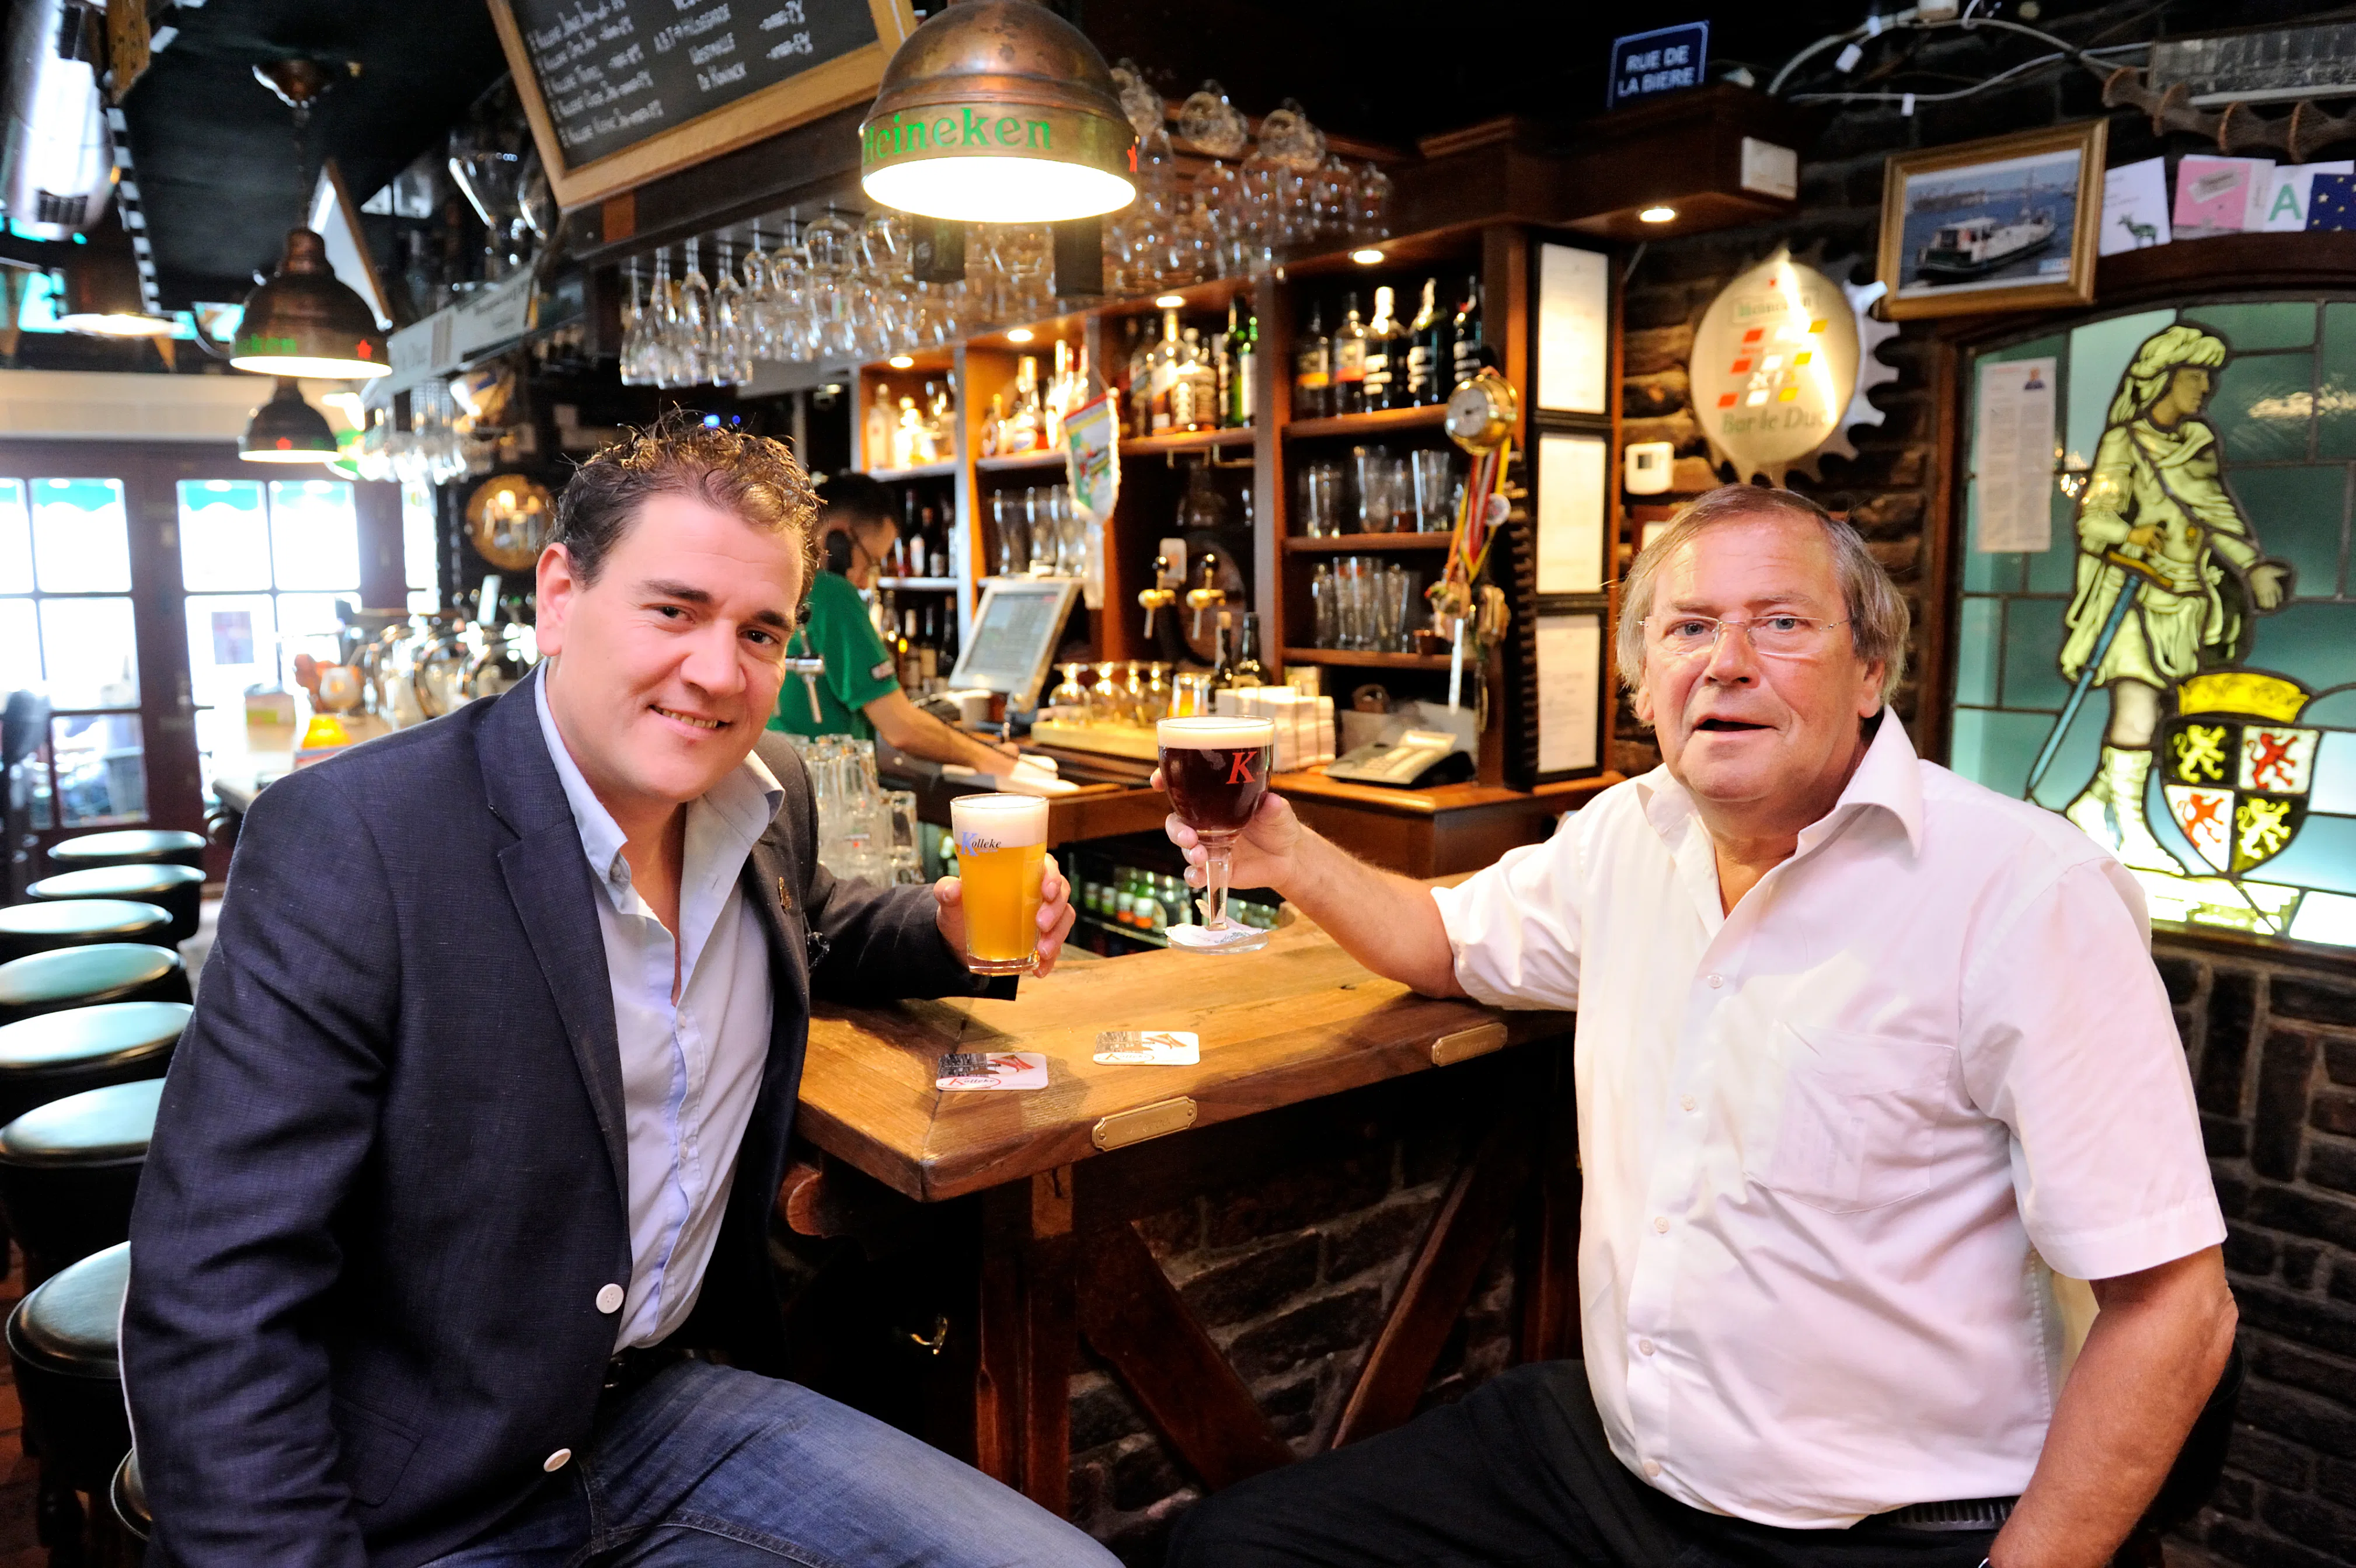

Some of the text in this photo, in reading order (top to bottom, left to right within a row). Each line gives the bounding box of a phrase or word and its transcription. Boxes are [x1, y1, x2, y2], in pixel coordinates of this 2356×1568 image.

[1625, 44, 1690, 73] RUE DE
[1618, 77, 1639, 97] LA
[863, 107, 1051, 165] Heineken
[2268, 183, 2302, 221] A
[1226, 751, 1257, 784] K
[961, 831, 1001, 856] Kolleke
